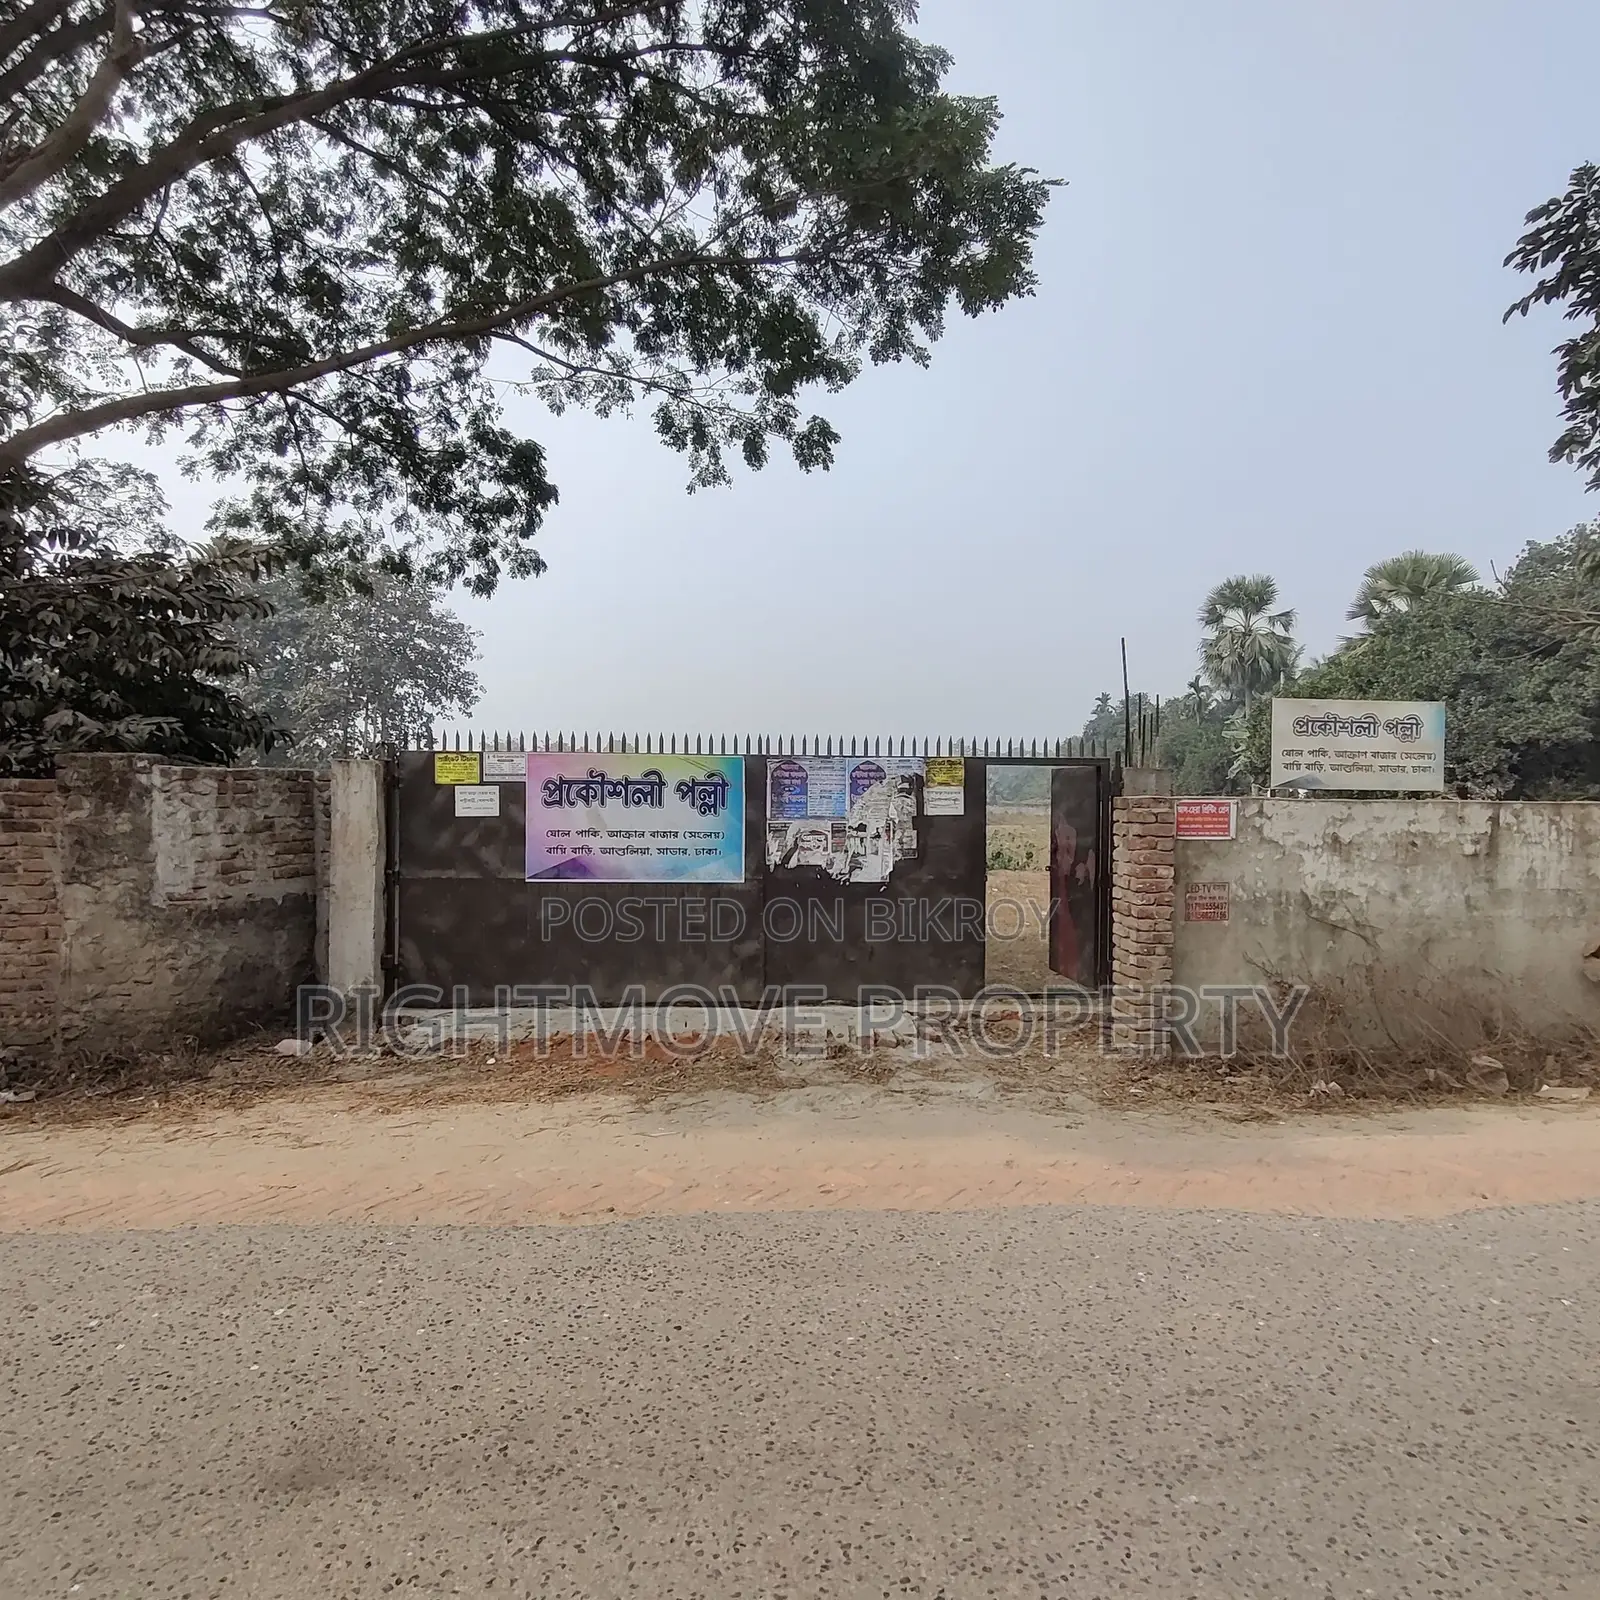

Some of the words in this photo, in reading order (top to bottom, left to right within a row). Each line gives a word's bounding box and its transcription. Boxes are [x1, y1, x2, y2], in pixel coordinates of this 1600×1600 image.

[1292, 712, 1381, 738] প্রকৌশলী
[1383, 714, 1424, 743] পল্লী
[1307, 747, 1331, 759] পাকি,
[1370, 751, 1397, 760] বাজার
[1329, 762, 1375, 773] আশুলিয়া,
[1378, 764, 1408, 774] সাভার,
[541, 768, 669, 808] প্রকৌশলী
[674, 772, 731, 817] পল্লী
[575, 827, 603, 840] পাকি,
[607, 830, 646, 840] আক্রান
[649, 830, 679, 840] বাজার
[600, 845, 653, 857] আশুলিয়া,
[656, 847, 691, 857] সাভার,
[694, 847, 722, 857] ঢাকা।
